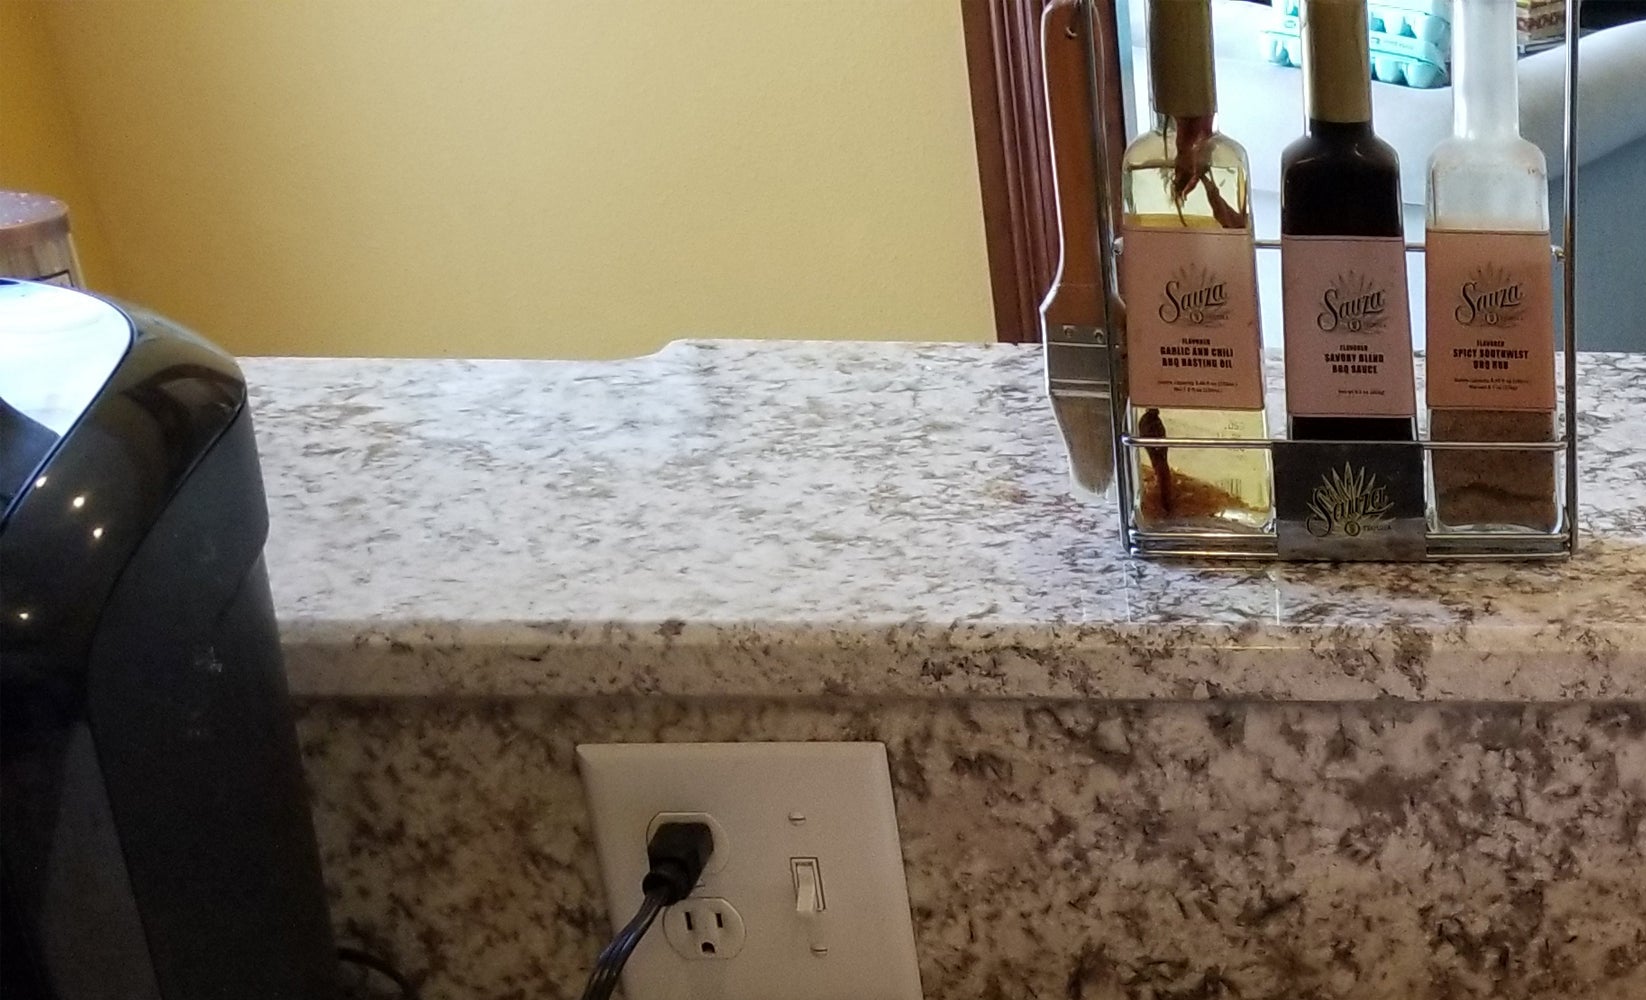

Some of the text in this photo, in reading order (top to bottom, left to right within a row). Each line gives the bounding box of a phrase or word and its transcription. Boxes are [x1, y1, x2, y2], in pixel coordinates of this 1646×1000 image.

[1159, 281, 1227, 323] Sauza
[1455, 282, 1522, 325] Sauza
[1317, 289, 1385, 332] Sauza
[1160, 347, 1234, 357] GARLIC AND CHILI
[1453, 349, 1529, 359] SPICY SOUTHWEST
[1162, 358, 1233, 369] BBQ BASTING OIL
[1324, 354, 1384, 363] SAVORY BLEND
[1332, 365, 1378, 374] BBQ SAUCE
[1473, 360, 1509, 369] BBQ RUB
[1306, 486, 1395, 537] Sauza
